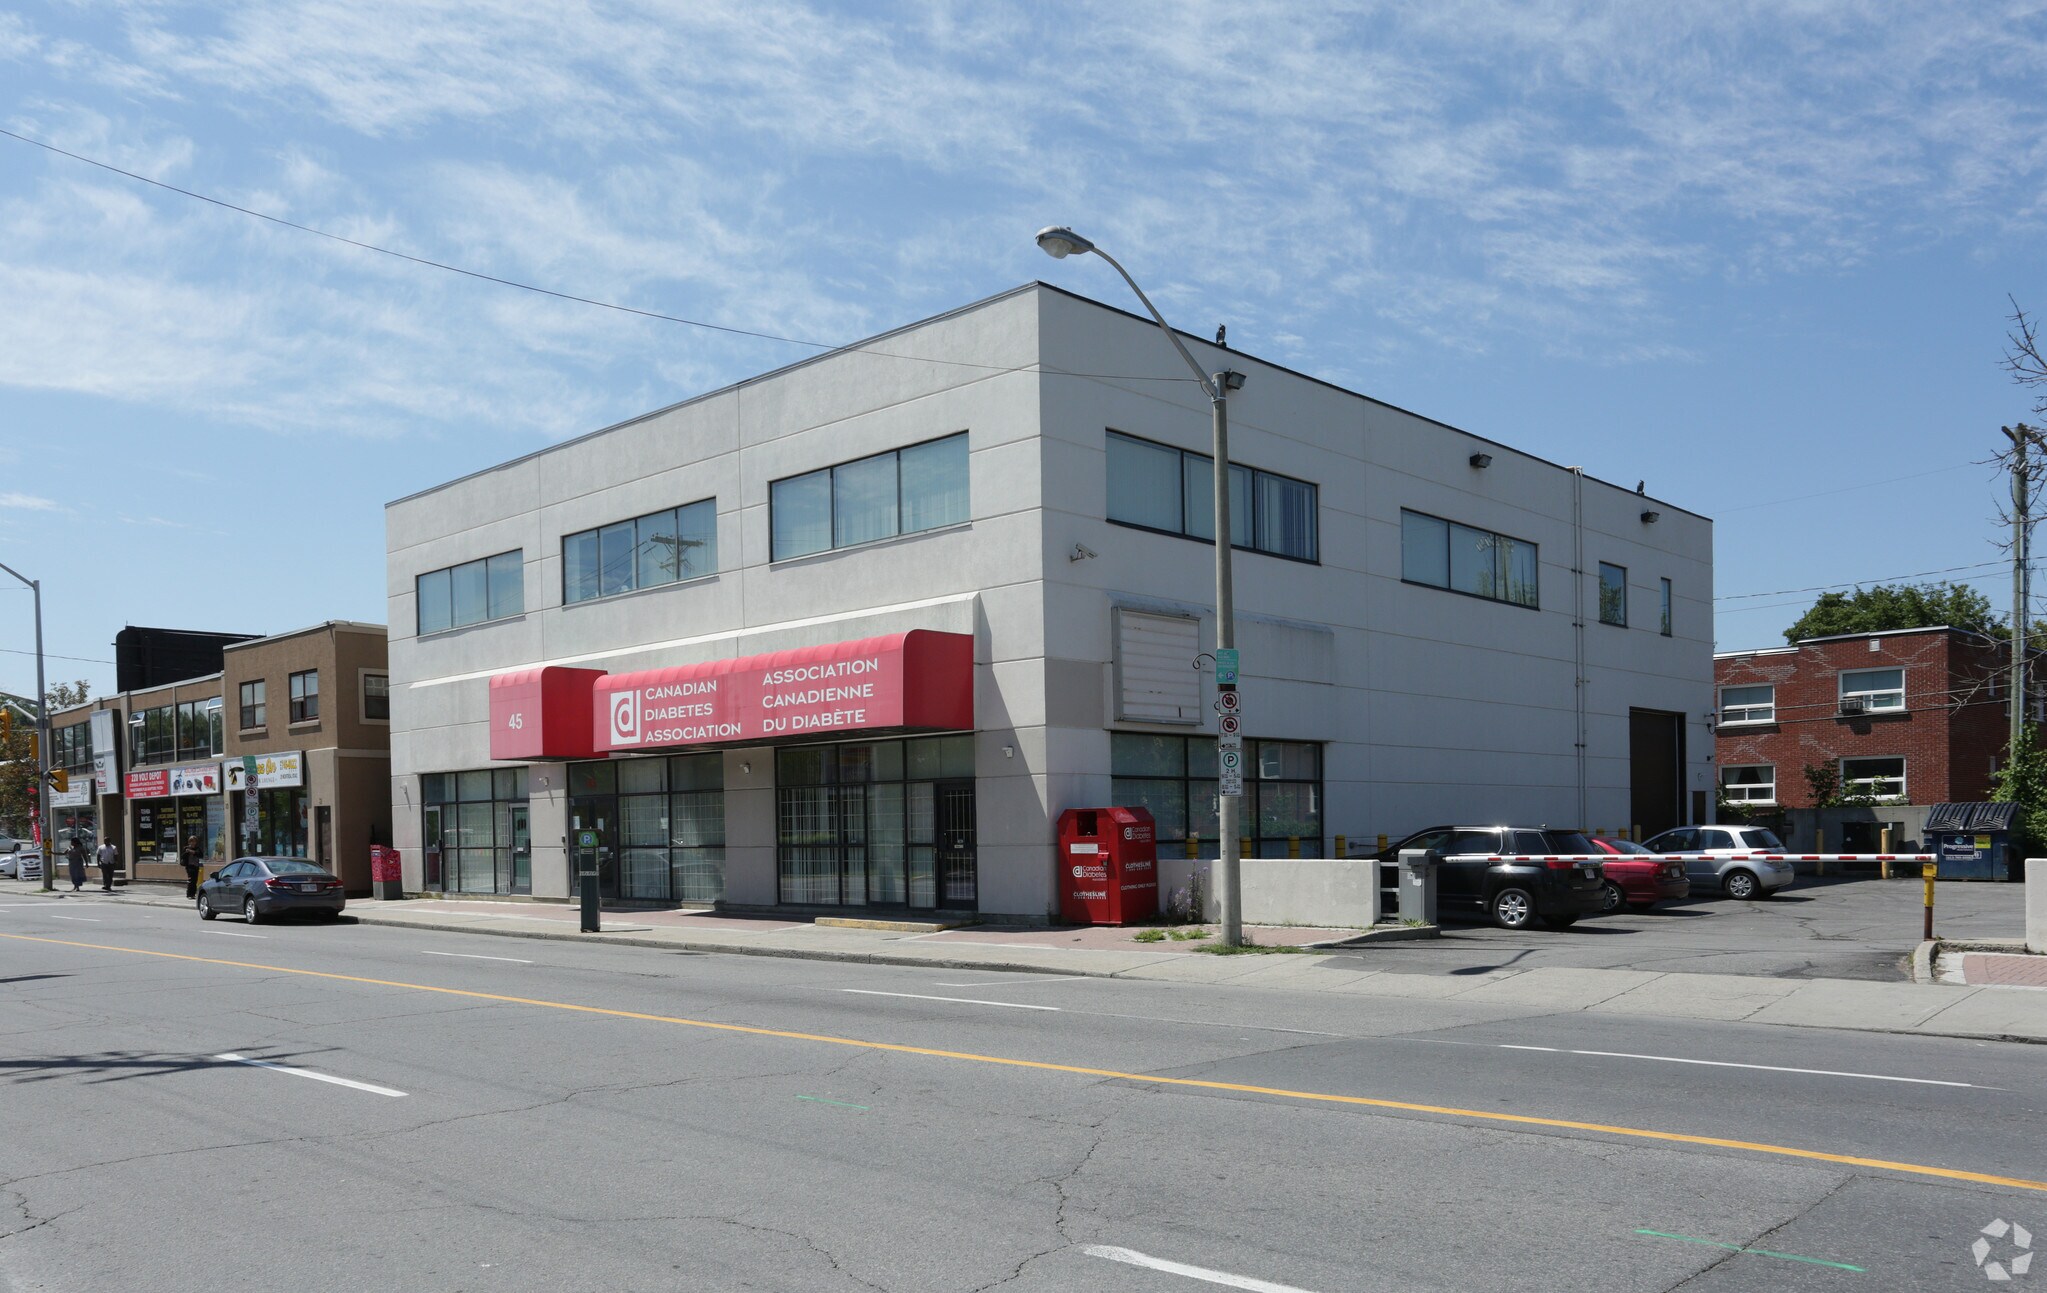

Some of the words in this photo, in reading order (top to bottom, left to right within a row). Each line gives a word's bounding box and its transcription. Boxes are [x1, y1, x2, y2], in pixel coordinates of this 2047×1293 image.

[762, 658, 878, 685] ASSOCIATION
[645, 680, 717, 700] CANADIAN
[762, 683, 874, 708] CANADIENNE
[508, 713, 523, 729] 45
[645, 703, 713, 721] DIABETES
[763, 717, 786, 732] DU
[792, 708, 866, 729] DIABÈTE
[645, 722, 741, 743] ASSOCIATION
[1227, 755, 1235, 764] P
[139, 772, 148, 781] VOLT
[149, 771, 162, 781] DEPOT
[1125, 861, 1151, 869] CLOTHESLINE
